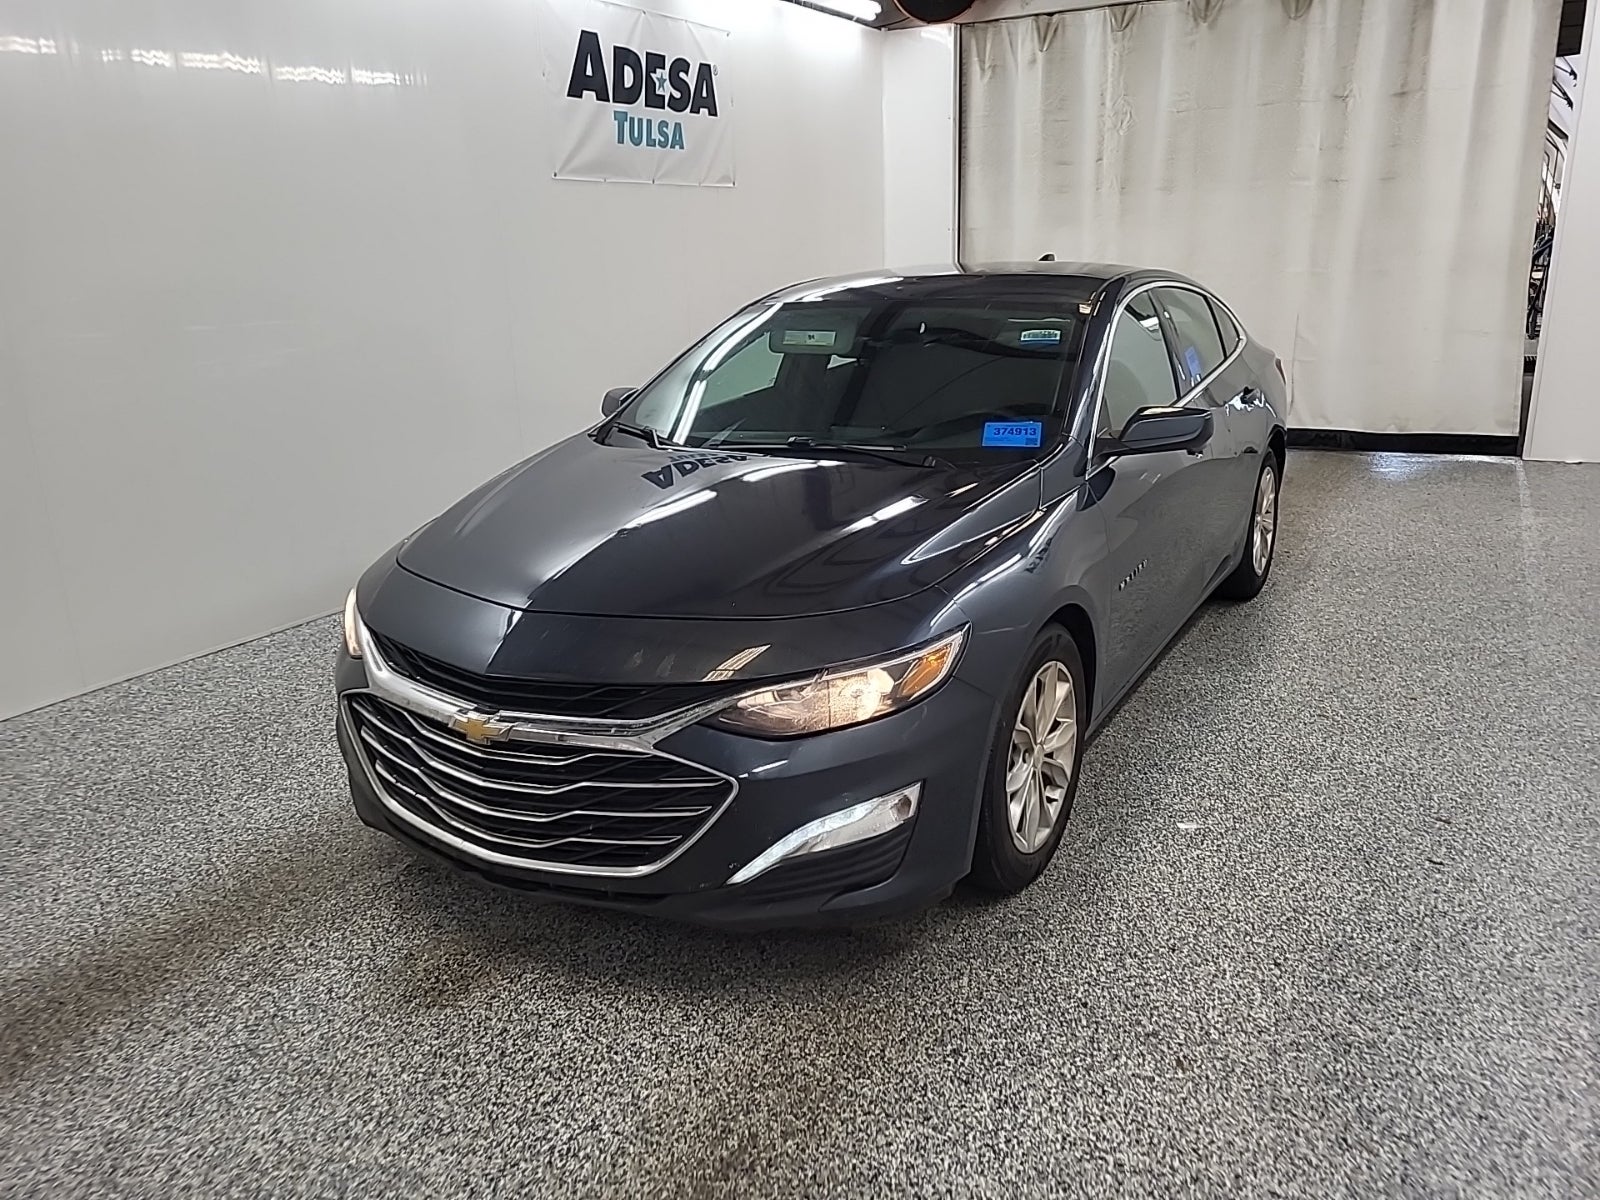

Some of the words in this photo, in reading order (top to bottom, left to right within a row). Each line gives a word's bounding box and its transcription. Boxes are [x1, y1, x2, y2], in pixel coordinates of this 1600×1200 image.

[566, 29, 718, 117] ADESA
[613, 110, 685, 149] TULSA
[993, 427, 1037, 436] 374913
